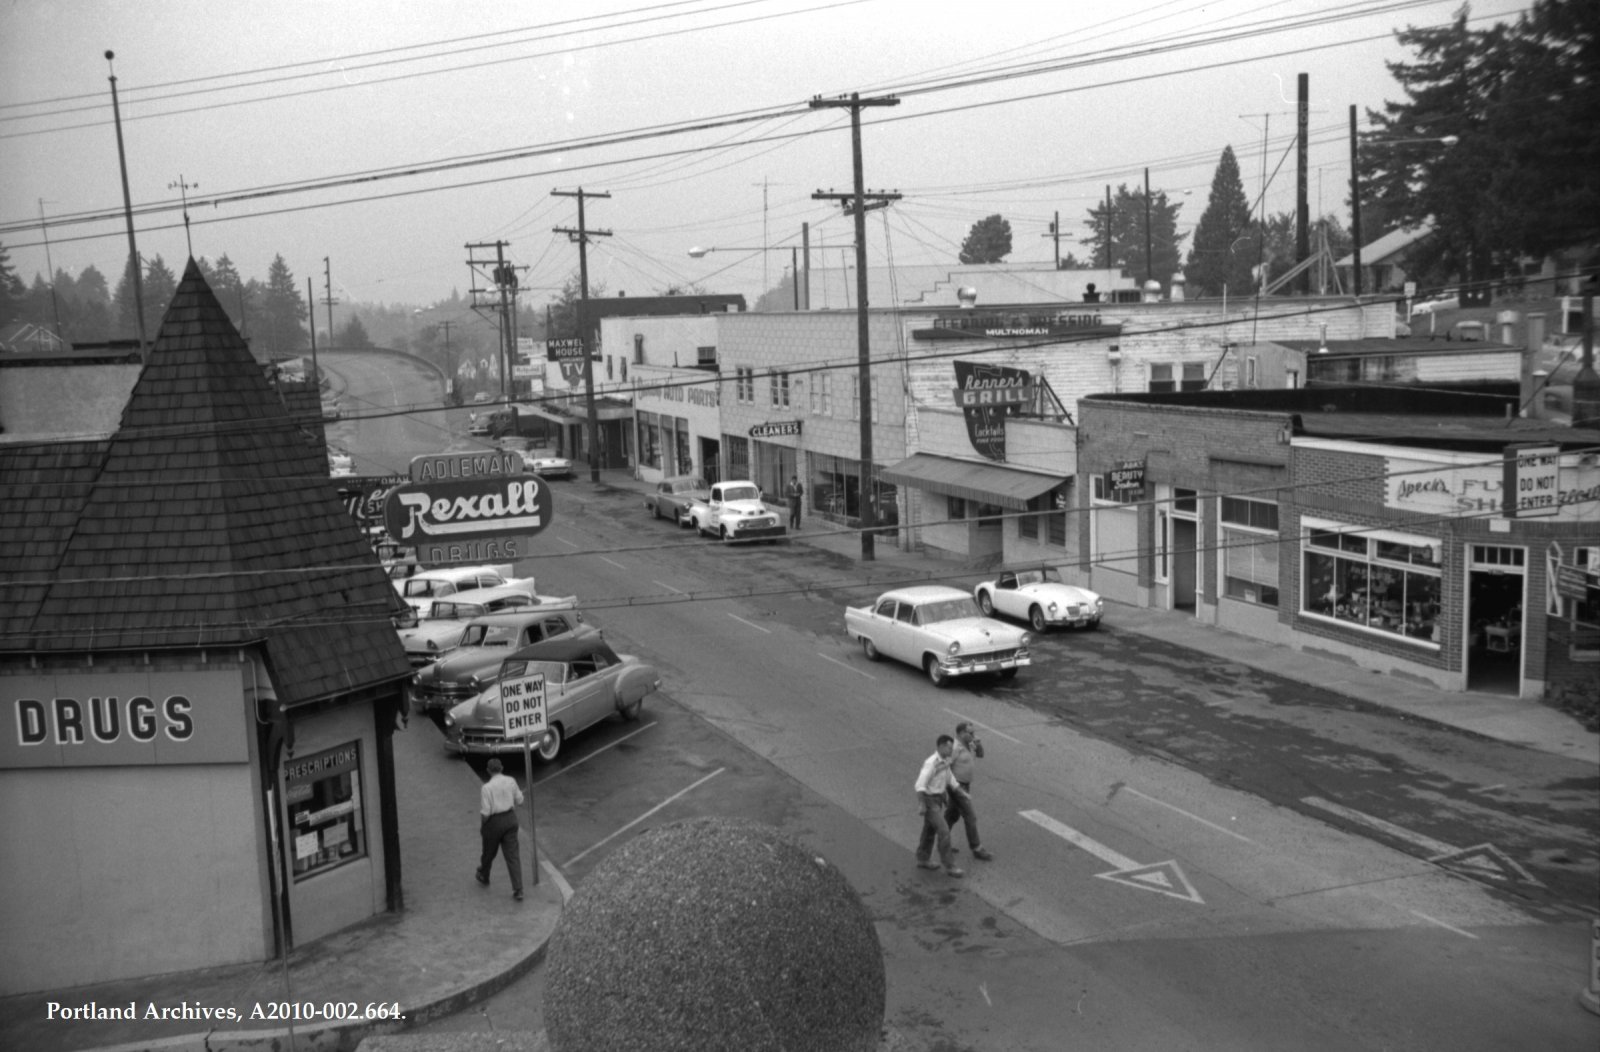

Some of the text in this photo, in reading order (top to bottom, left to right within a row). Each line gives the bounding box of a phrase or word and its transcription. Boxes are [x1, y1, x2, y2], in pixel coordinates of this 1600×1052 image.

[985, 327, 1049, 336] MULTNOMAH
[548, 339, 584, 348] MAXWEL
[555, 347, 583, 356] HOUSE
[562, 362, 585, 376] TV
[964, 371, 1023, 390] Renner's
[963, 389, 1028, 404] GRILL
[752, 424, 799, 437] CLEANERS
[421, 455, 515, 480] ADLEMAN
[1111, 470, 1143, 481] BEAUTY
[1520, 475, 1556, 491] DO NOT
[398, 480, 540, 538] Rexall
[1521, 494, 1553, 509] ENTER
[431, 540, 517, 564] DRUGS
[502, 679, 544, 698] ONE WAY
[506, 695, 542, 714] DO NOT
[15, 695, 193, 746] DRUGS
[508, 711, 542, 730] ENTER
[283, 748, 357, 781] PRESCRIPTIONS
